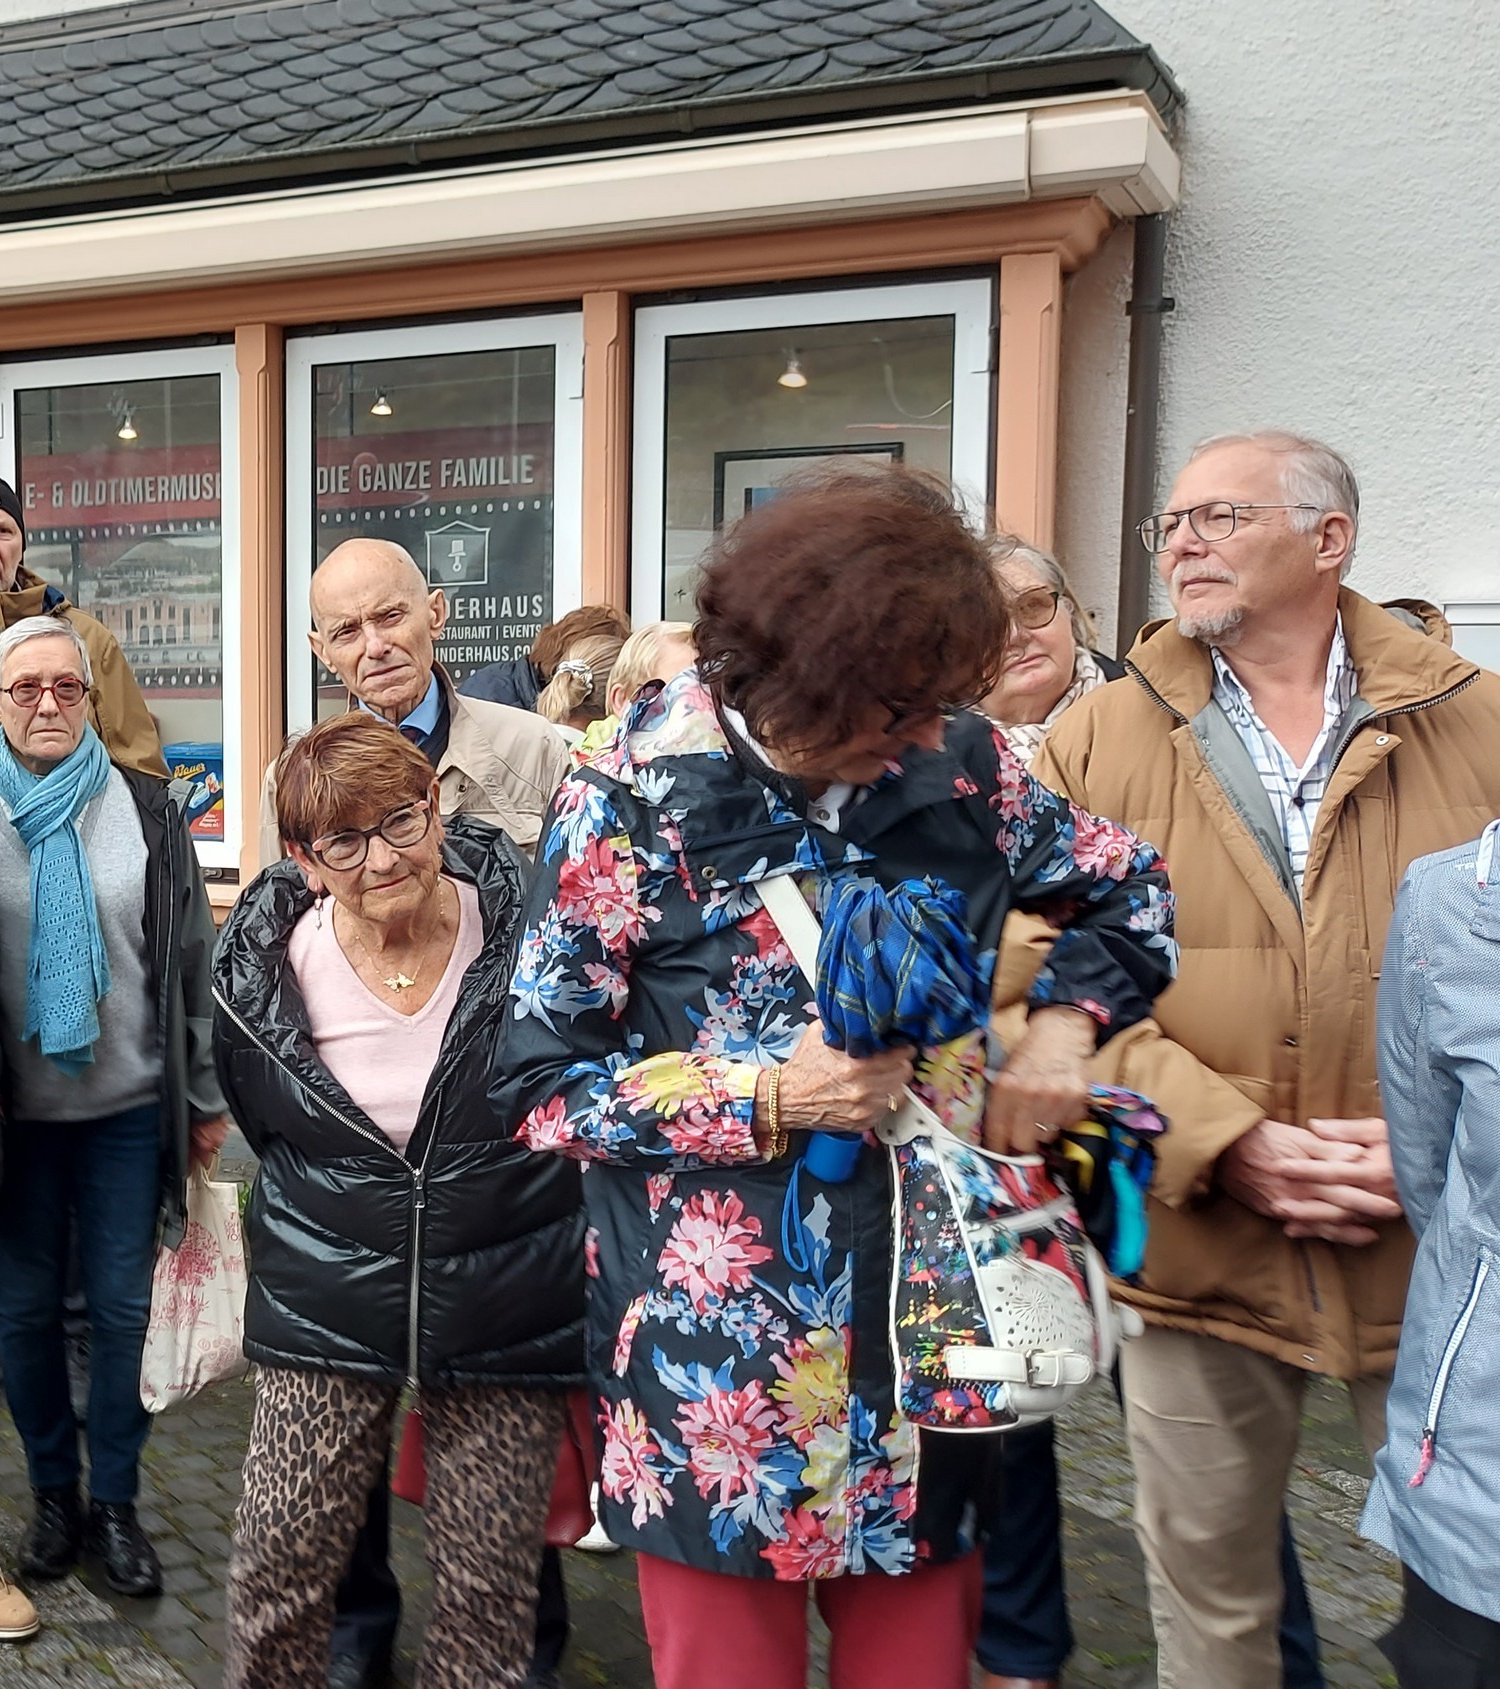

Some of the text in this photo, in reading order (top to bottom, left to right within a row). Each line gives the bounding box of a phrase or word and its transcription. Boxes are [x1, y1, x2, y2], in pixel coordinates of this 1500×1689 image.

[52, 481, 64, 508] &
[71, 471, 220, 509] OLDTIMERMUS
[316, 465, 350, 494] DIE
[358, 460, 432, 493] GANZE
[440, 453, 535, 488] FAMILIE
[440, 625, 492, 641] STAURANT
[503, 623, 542, 639] EVENTS
[435, 644, 531, 663] INDERHAUS.CO
